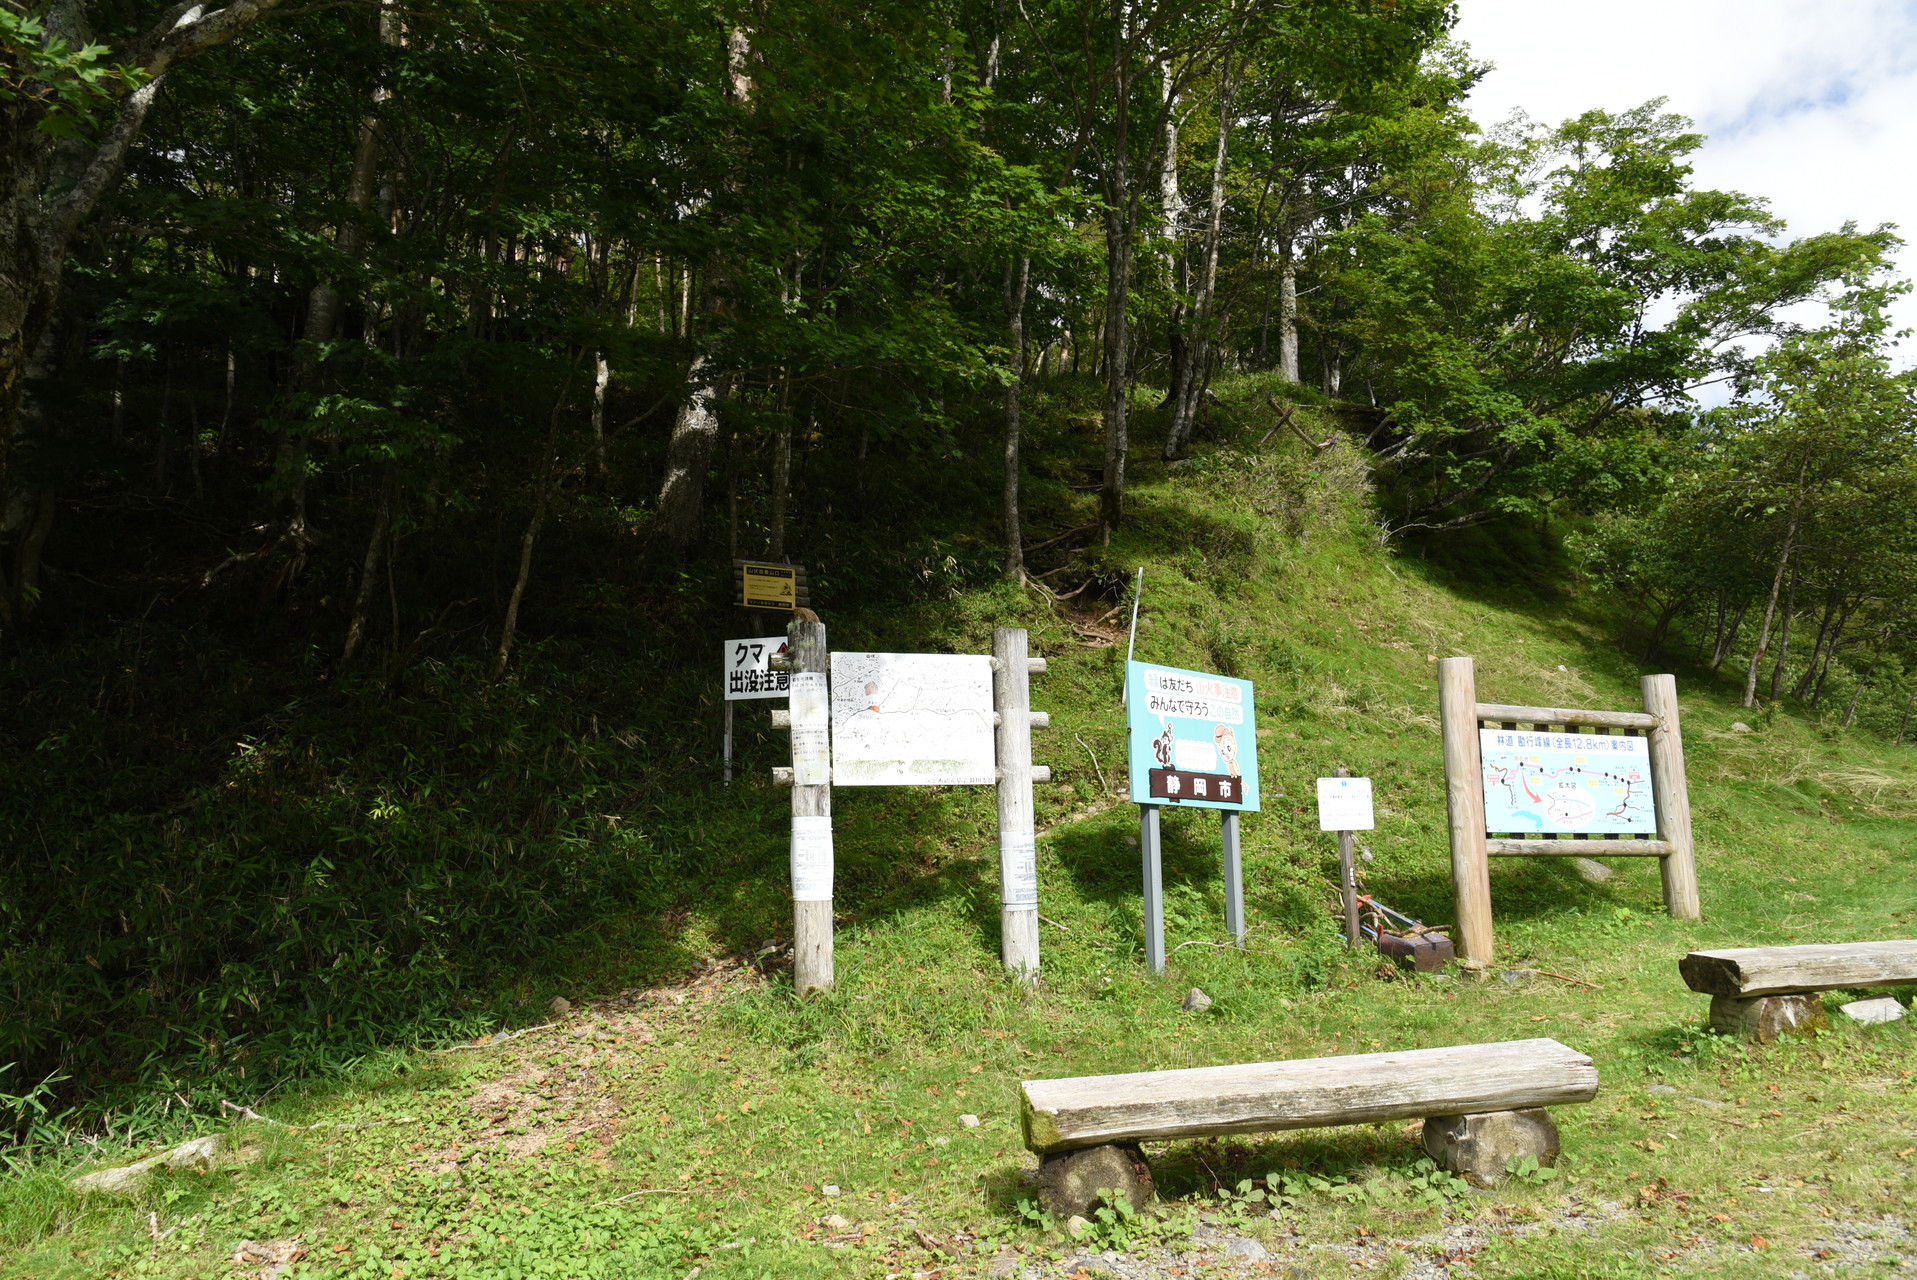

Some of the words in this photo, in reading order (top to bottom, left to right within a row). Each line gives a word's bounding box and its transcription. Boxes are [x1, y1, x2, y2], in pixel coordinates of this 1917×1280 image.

[735, 643, 763, 667] クマ
[729, 669, 790, 694] 出没注意
[1497, 735, 1514, 747] 林道
[1166, 775, 1232, 798] 静岡市
